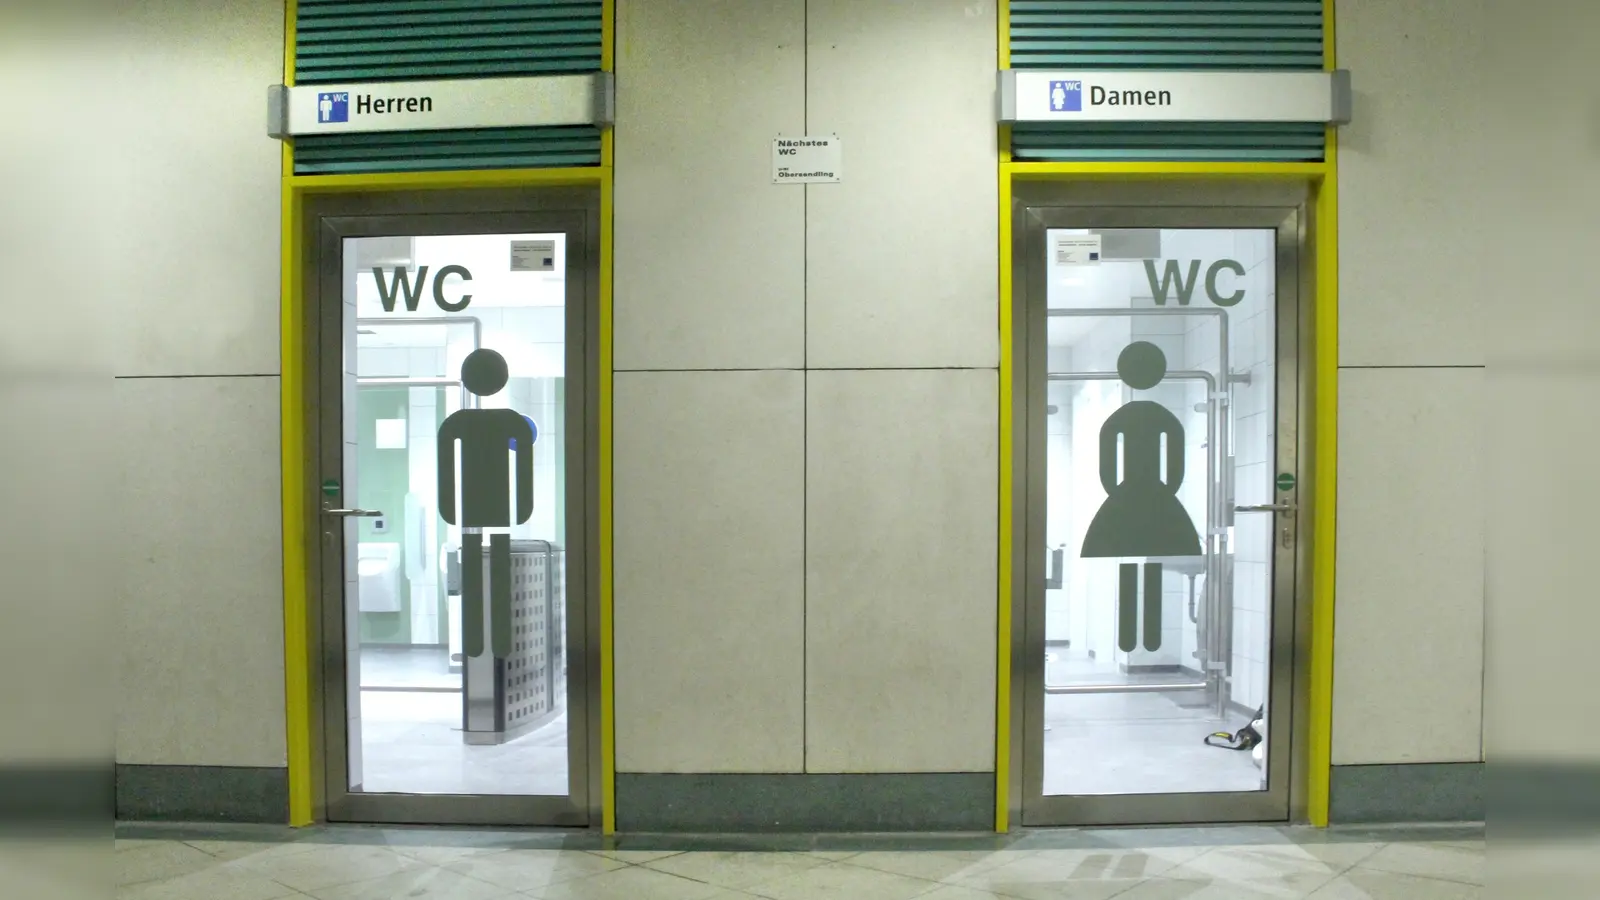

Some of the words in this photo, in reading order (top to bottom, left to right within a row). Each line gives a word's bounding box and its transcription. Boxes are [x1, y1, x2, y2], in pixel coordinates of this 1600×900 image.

[1064, 82, 1081, 91] WC
[1090, 85, 1171, 106] Damen
[332, 93, 348, 103] WC
[357, 94, 432, 115] Herren
[372, 264, 473, 313] WC
[1143, 258, 1246, 307] WC
